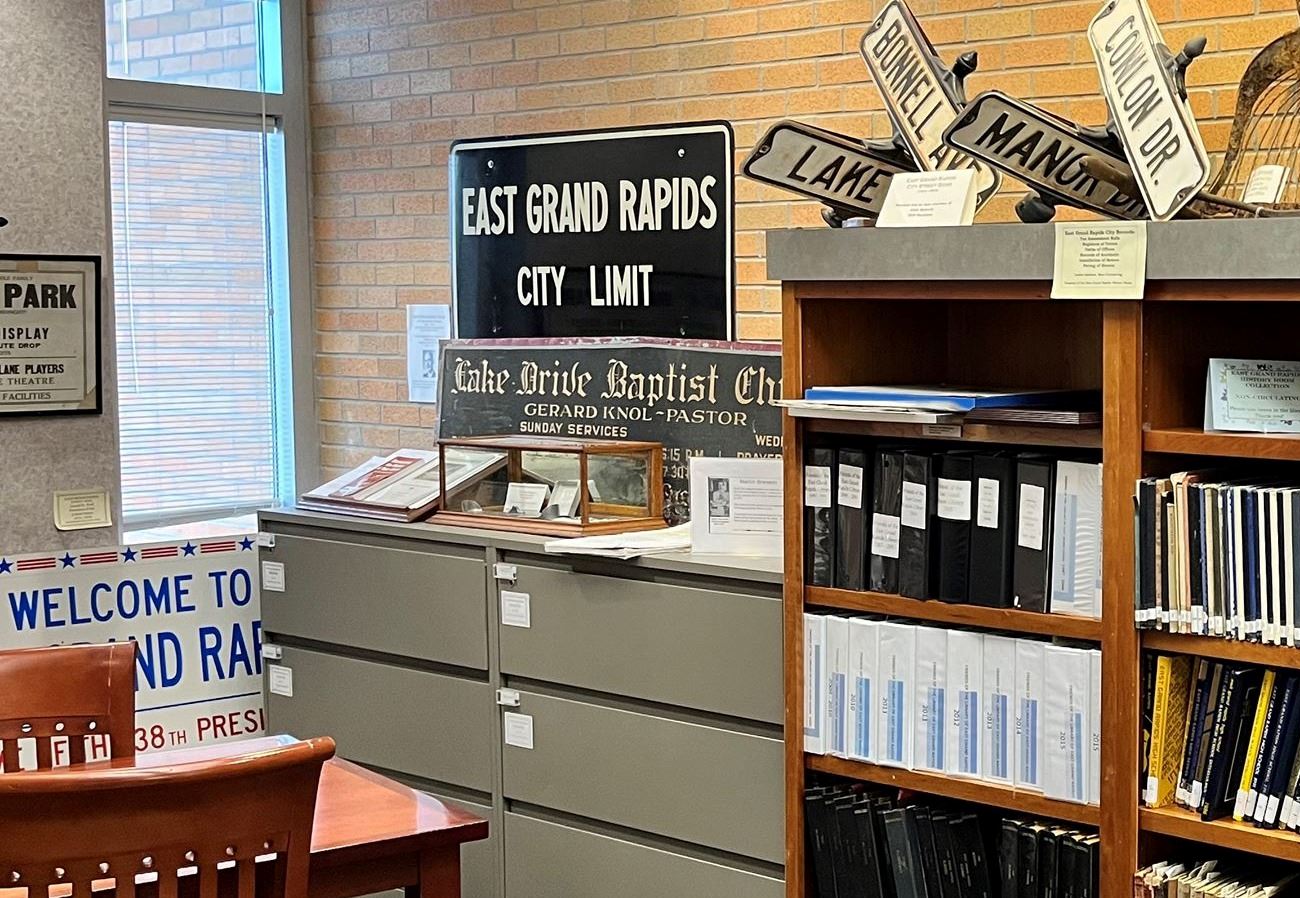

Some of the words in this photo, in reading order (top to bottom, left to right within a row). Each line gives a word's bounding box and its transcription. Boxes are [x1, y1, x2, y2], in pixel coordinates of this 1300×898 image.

[872, 19, 943, 142] BONNELL
[1106, 15, 1163, 130] CONLON
[1140, 117, 1181, 186] DR.
[787, 145, 894, 204] LAKE
[462, 185, 518, 236] EAST
[526, 181, 609, 234] GRAND
[619, 175, 718, 232] RAPIDS
[4, 283, 77, 309] PARK
[516, 265, 567, 306] CITY
[589, 264, 654, 307] LIMIT
[8, 377, 55, 385] THEATRE
[25, 363, 65, 375] PLAYERS
[451, 357, 511, 395] Lake
[515, 358, 593, 396] Drive
[600, 358, 719, 407] Baptist
[2, 392, 52, 401] FACILITIES
[524, 403, 598, 419] GERARD
[602, 407, 653, 421] KNOL
[666, 409, 748, 427] PASTOR
[519, 422, 563, 435] SUNDAY
[567, 424, 628, 438] SERVICES
[8, 575, 196, 631] WELCOME
[208, 568, 251, 608] TO
